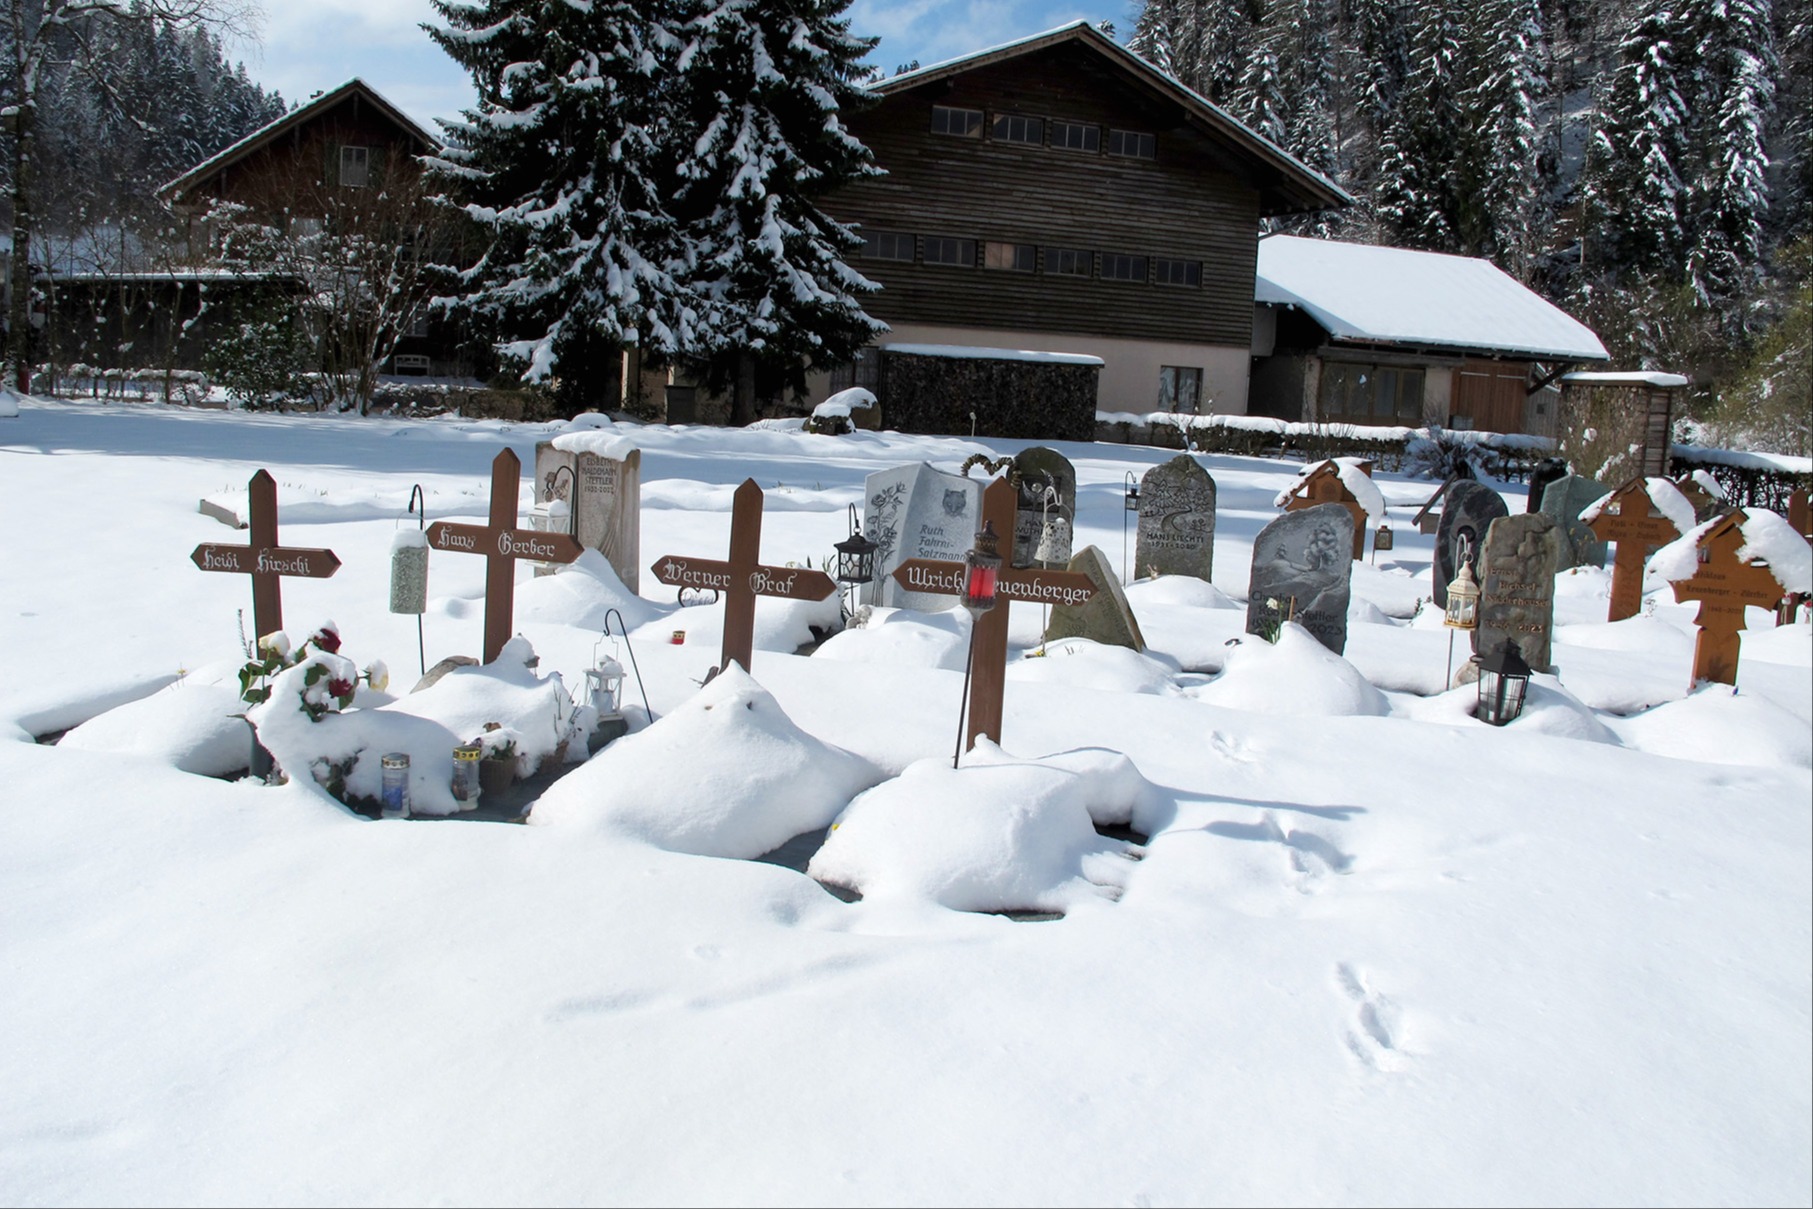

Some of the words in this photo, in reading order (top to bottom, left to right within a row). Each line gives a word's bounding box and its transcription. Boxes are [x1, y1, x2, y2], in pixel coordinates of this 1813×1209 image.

[585, 476, 614, 485] STETTLER
[920, 524, 944, 536] Ruth
[1147, 532, 1170, 541] HANS
[438, 524, 476, 549] Hans
[497, 529, 557, 557] Gerber
[918, 536, 955, 549] Fahrni-
[202, 544, 240, 570] Heidi
[255, 547, 311, 576] Hirschi
[918, 547, 966, 561] Salzmann
[662, 558, 732, 588] Werner
[749, 568, 798, 594] Graf
[906, 567, 965, 594] Ulrich
[993, 577, 1092, 606] euenberger
